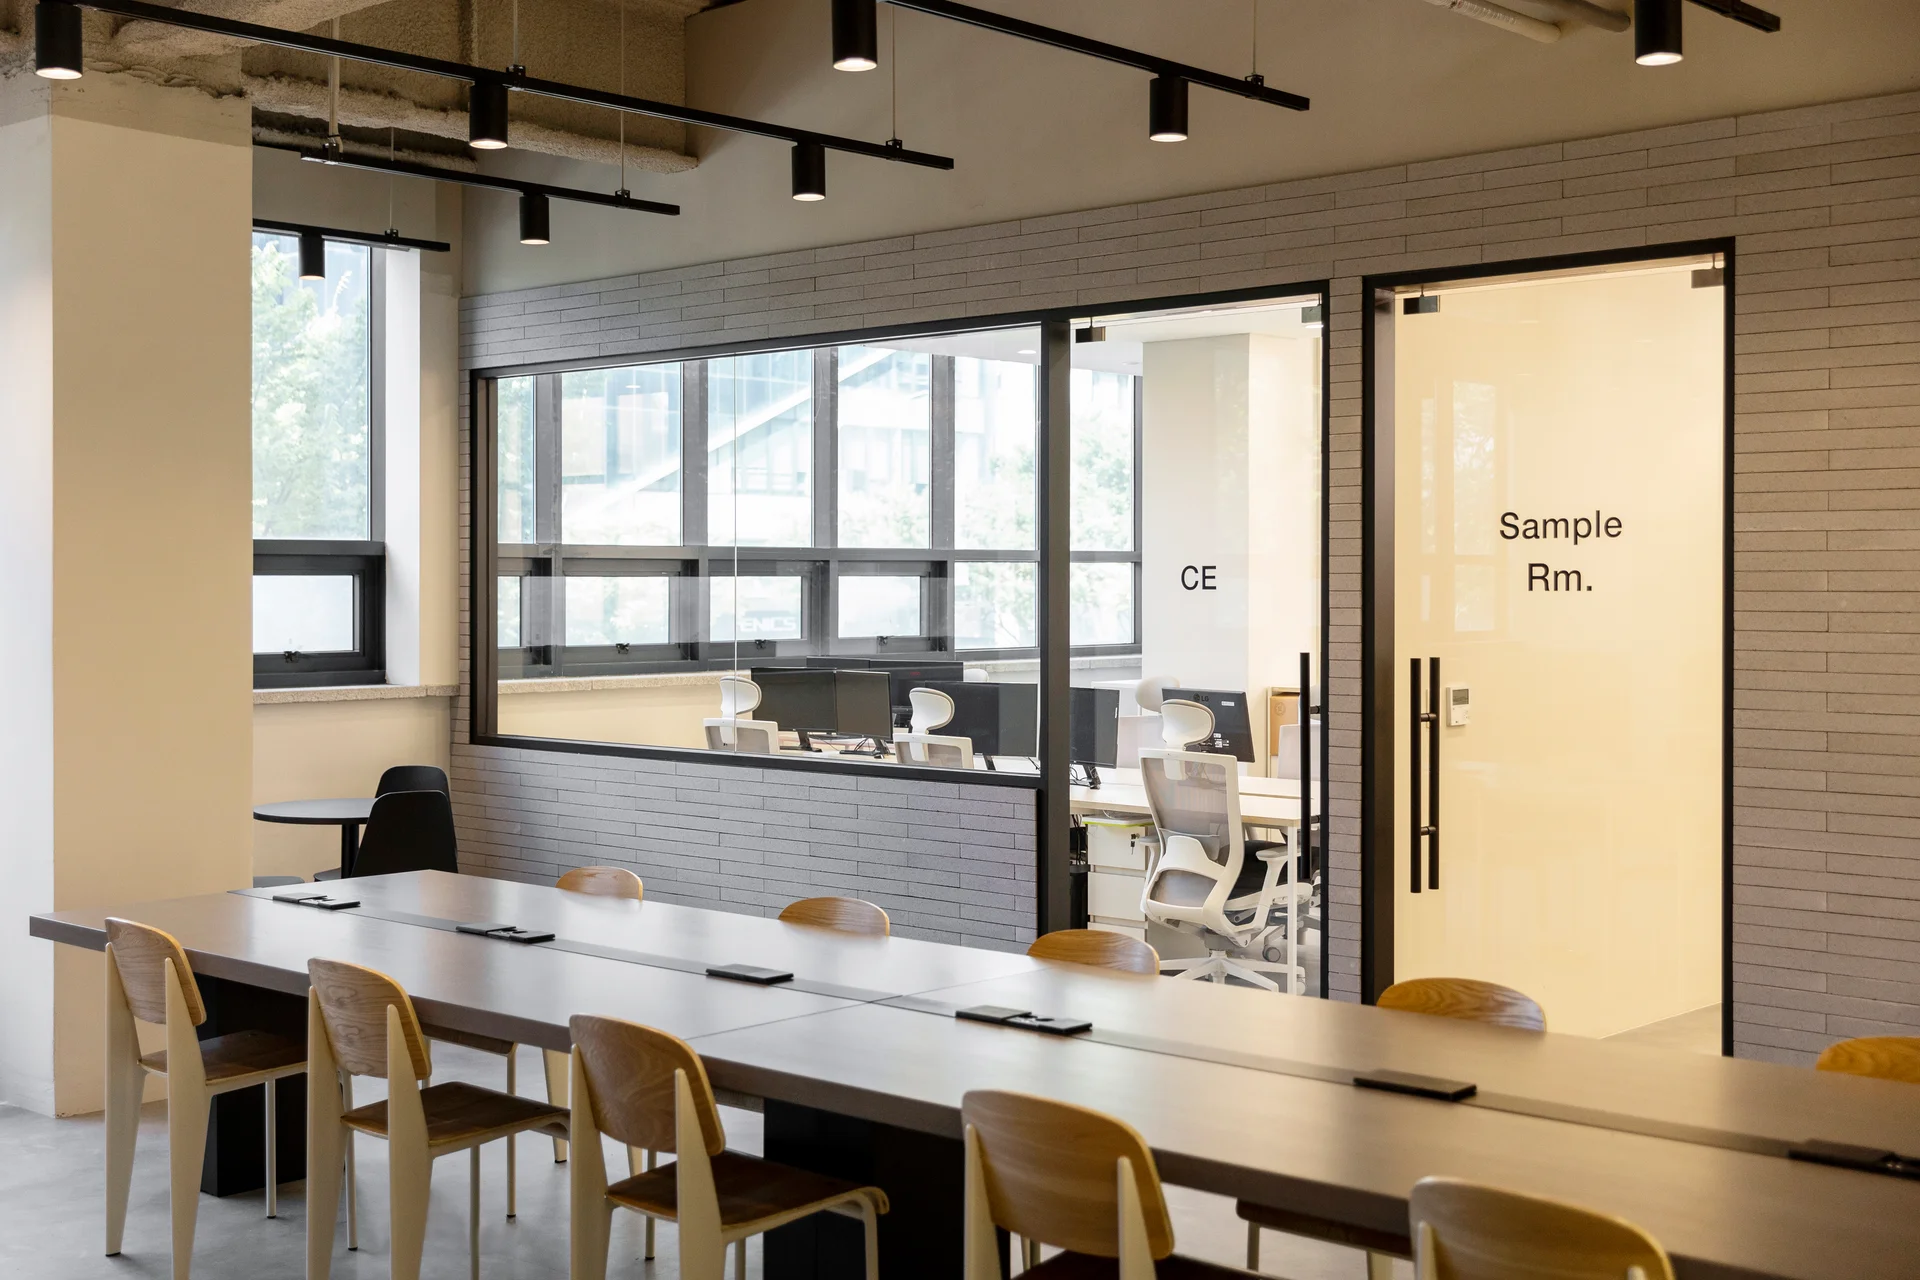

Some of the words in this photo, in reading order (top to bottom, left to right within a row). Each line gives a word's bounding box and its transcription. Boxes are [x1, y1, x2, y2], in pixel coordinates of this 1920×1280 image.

[1499, 509, 1623, 546] Sample
[1181, 565, 1217, 591] CE
[1528, 562, 1593, 592] Rm.
